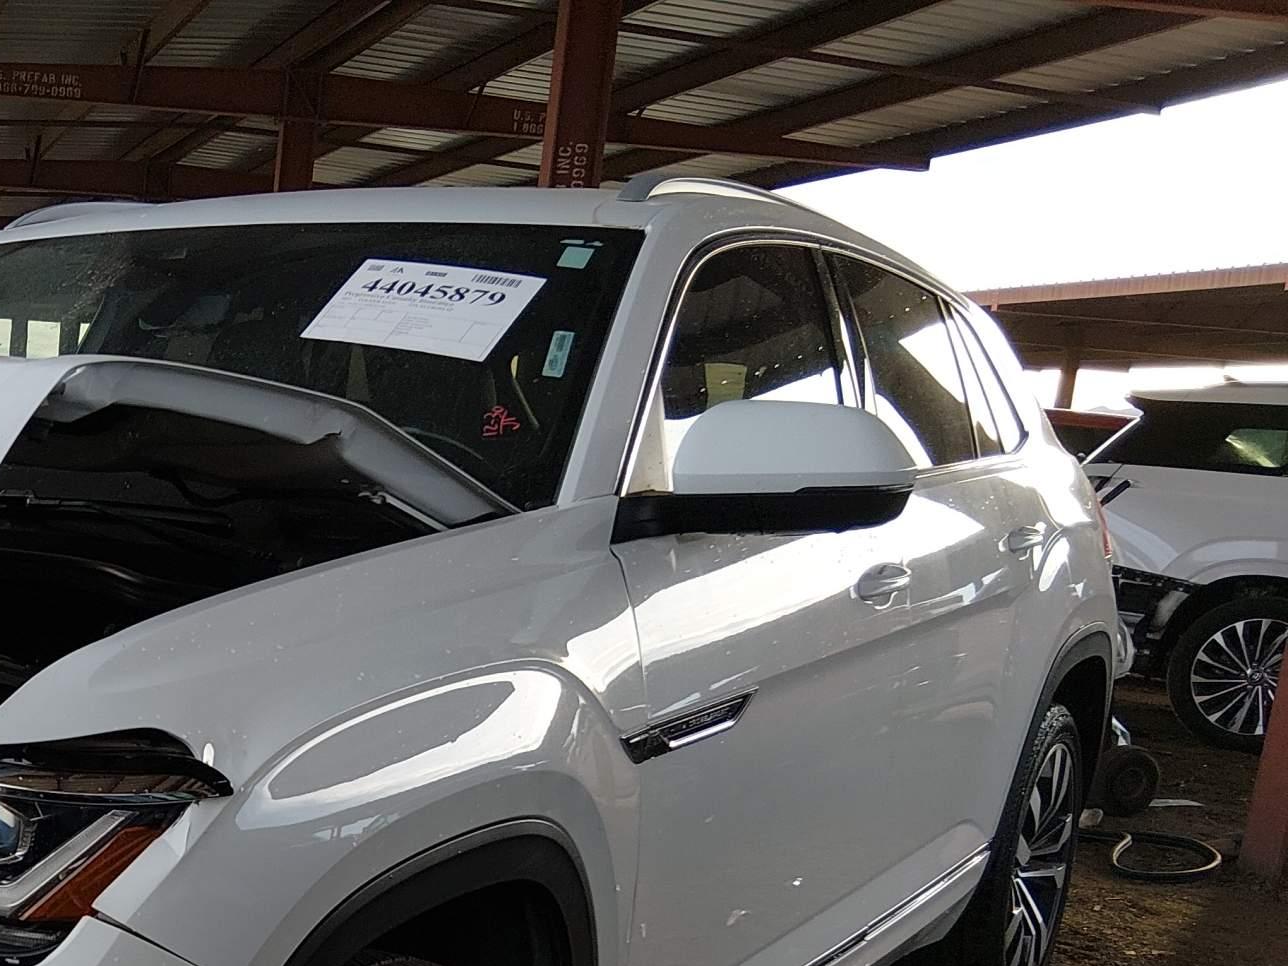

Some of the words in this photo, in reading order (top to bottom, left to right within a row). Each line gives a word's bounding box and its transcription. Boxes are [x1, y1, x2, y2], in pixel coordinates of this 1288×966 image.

[12, 70, 56, 84] PREFAB
[61, 74, 82, 87] INC.
[556, 141, 574, 175] INC.
[361, 277, 507, 307] 44045879
